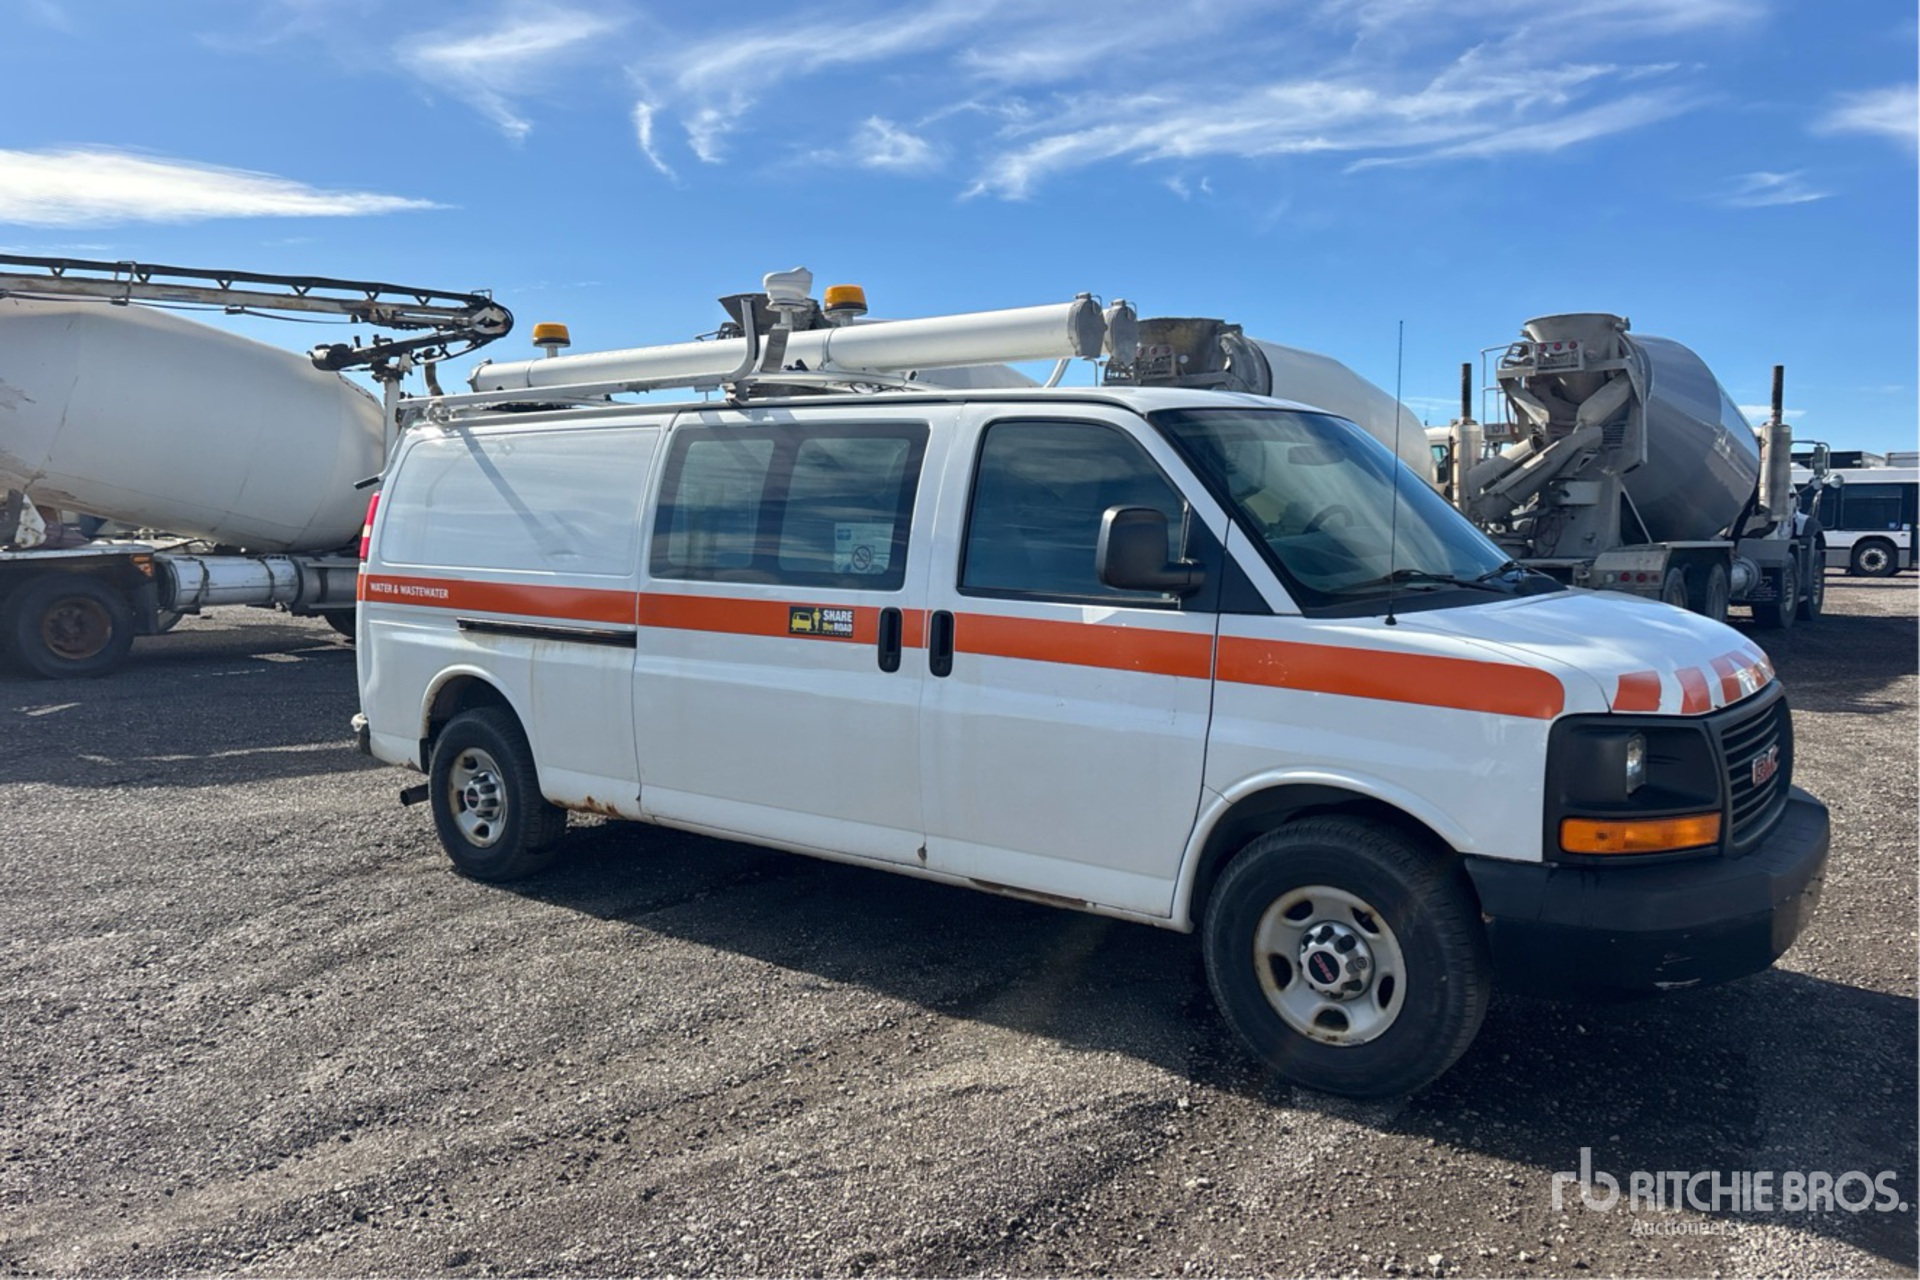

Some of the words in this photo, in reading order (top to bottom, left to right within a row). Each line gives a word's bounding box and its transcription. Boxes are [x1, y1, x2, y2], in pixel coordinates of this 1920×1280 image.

[370, 582, 392, 594] WATER
[393, 585, 399, 595] &
[400, 585, 449, 599] WASTEWATER
[823, 609, 853, 623] SHARE
[834, 623, 853, 632] ROAD
[1752, 744, 1779, 788] GMC
